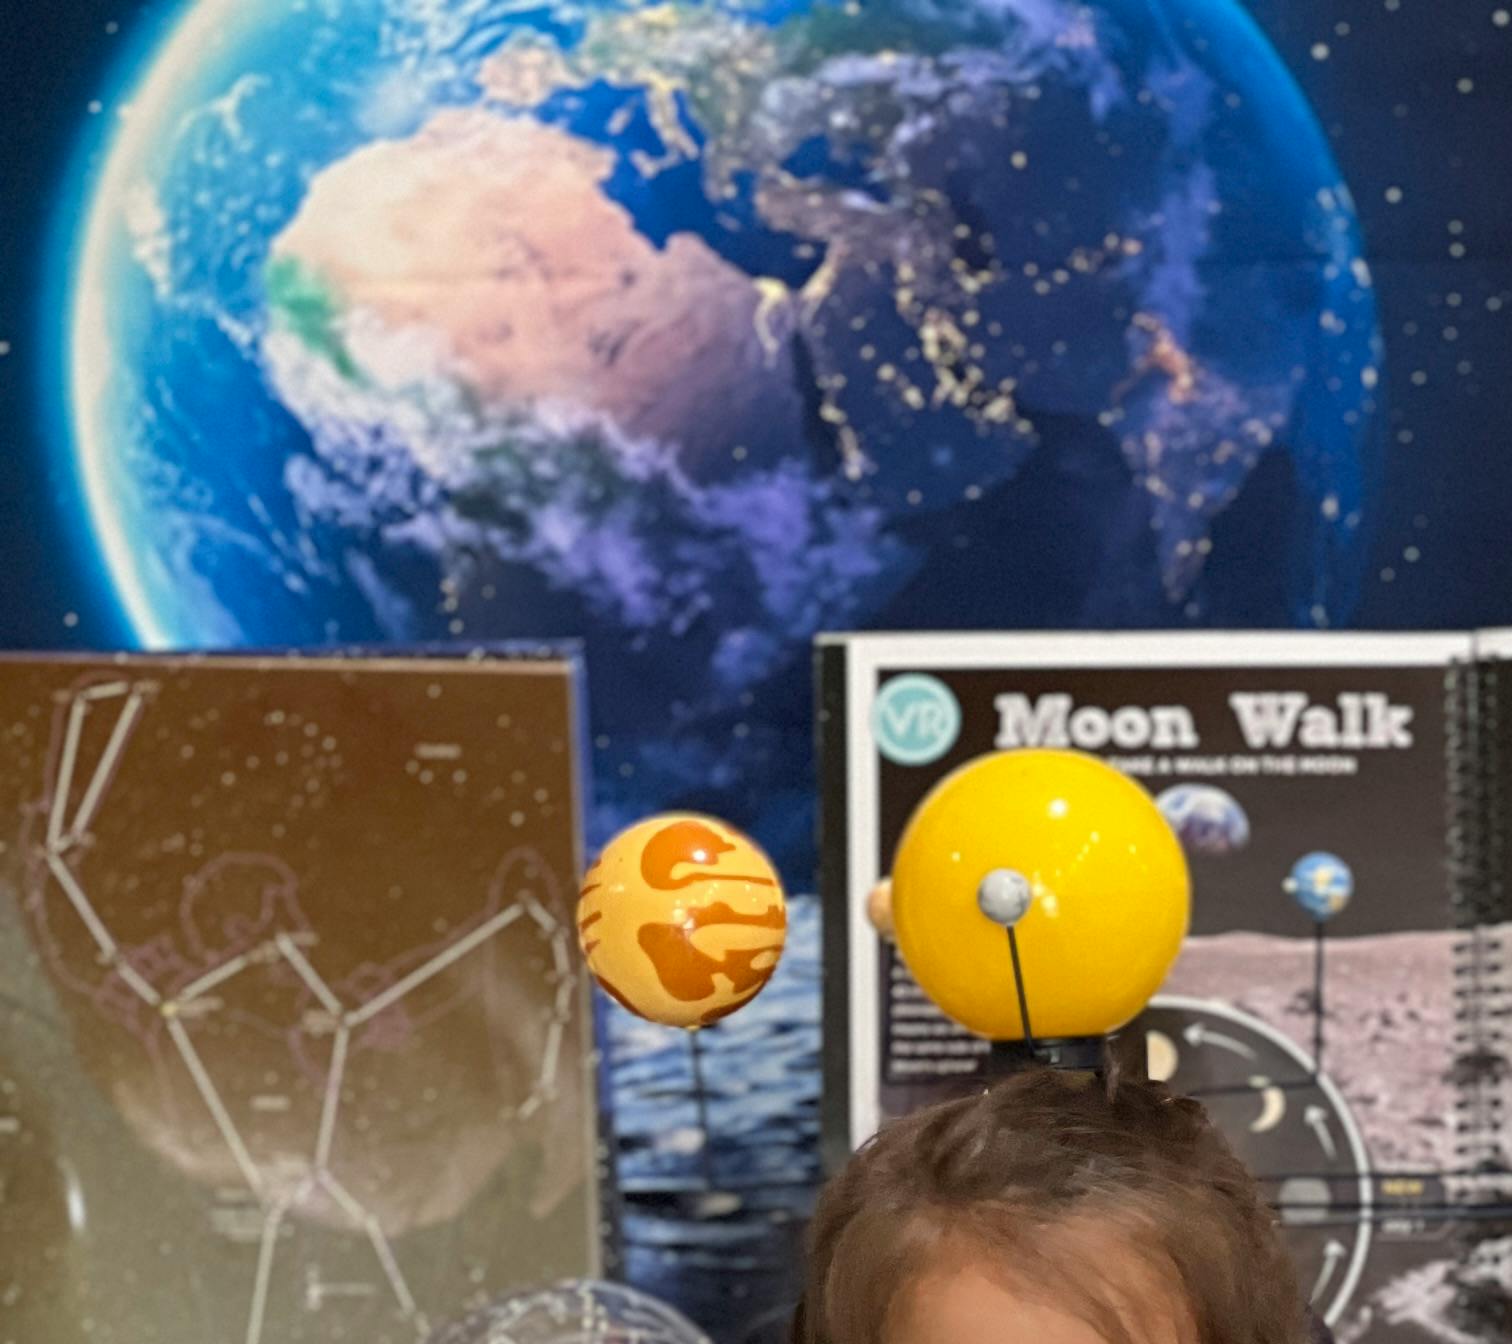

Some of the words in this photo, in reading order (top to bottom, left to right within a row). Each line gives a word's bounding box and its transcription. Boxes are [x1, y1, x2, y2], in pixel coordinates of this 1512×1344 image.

[994, 694, 1199, 750] Moon
[1229, 691, 1413, 750] Walk
[1156, 757, 1172, 773] A
[1173, 757, 1227, 773] WALK
[1228, 757, 1258, 773] ON
[1261, 757, 1297, 773] THE
[1299, 757, 1357, 773] MOON
